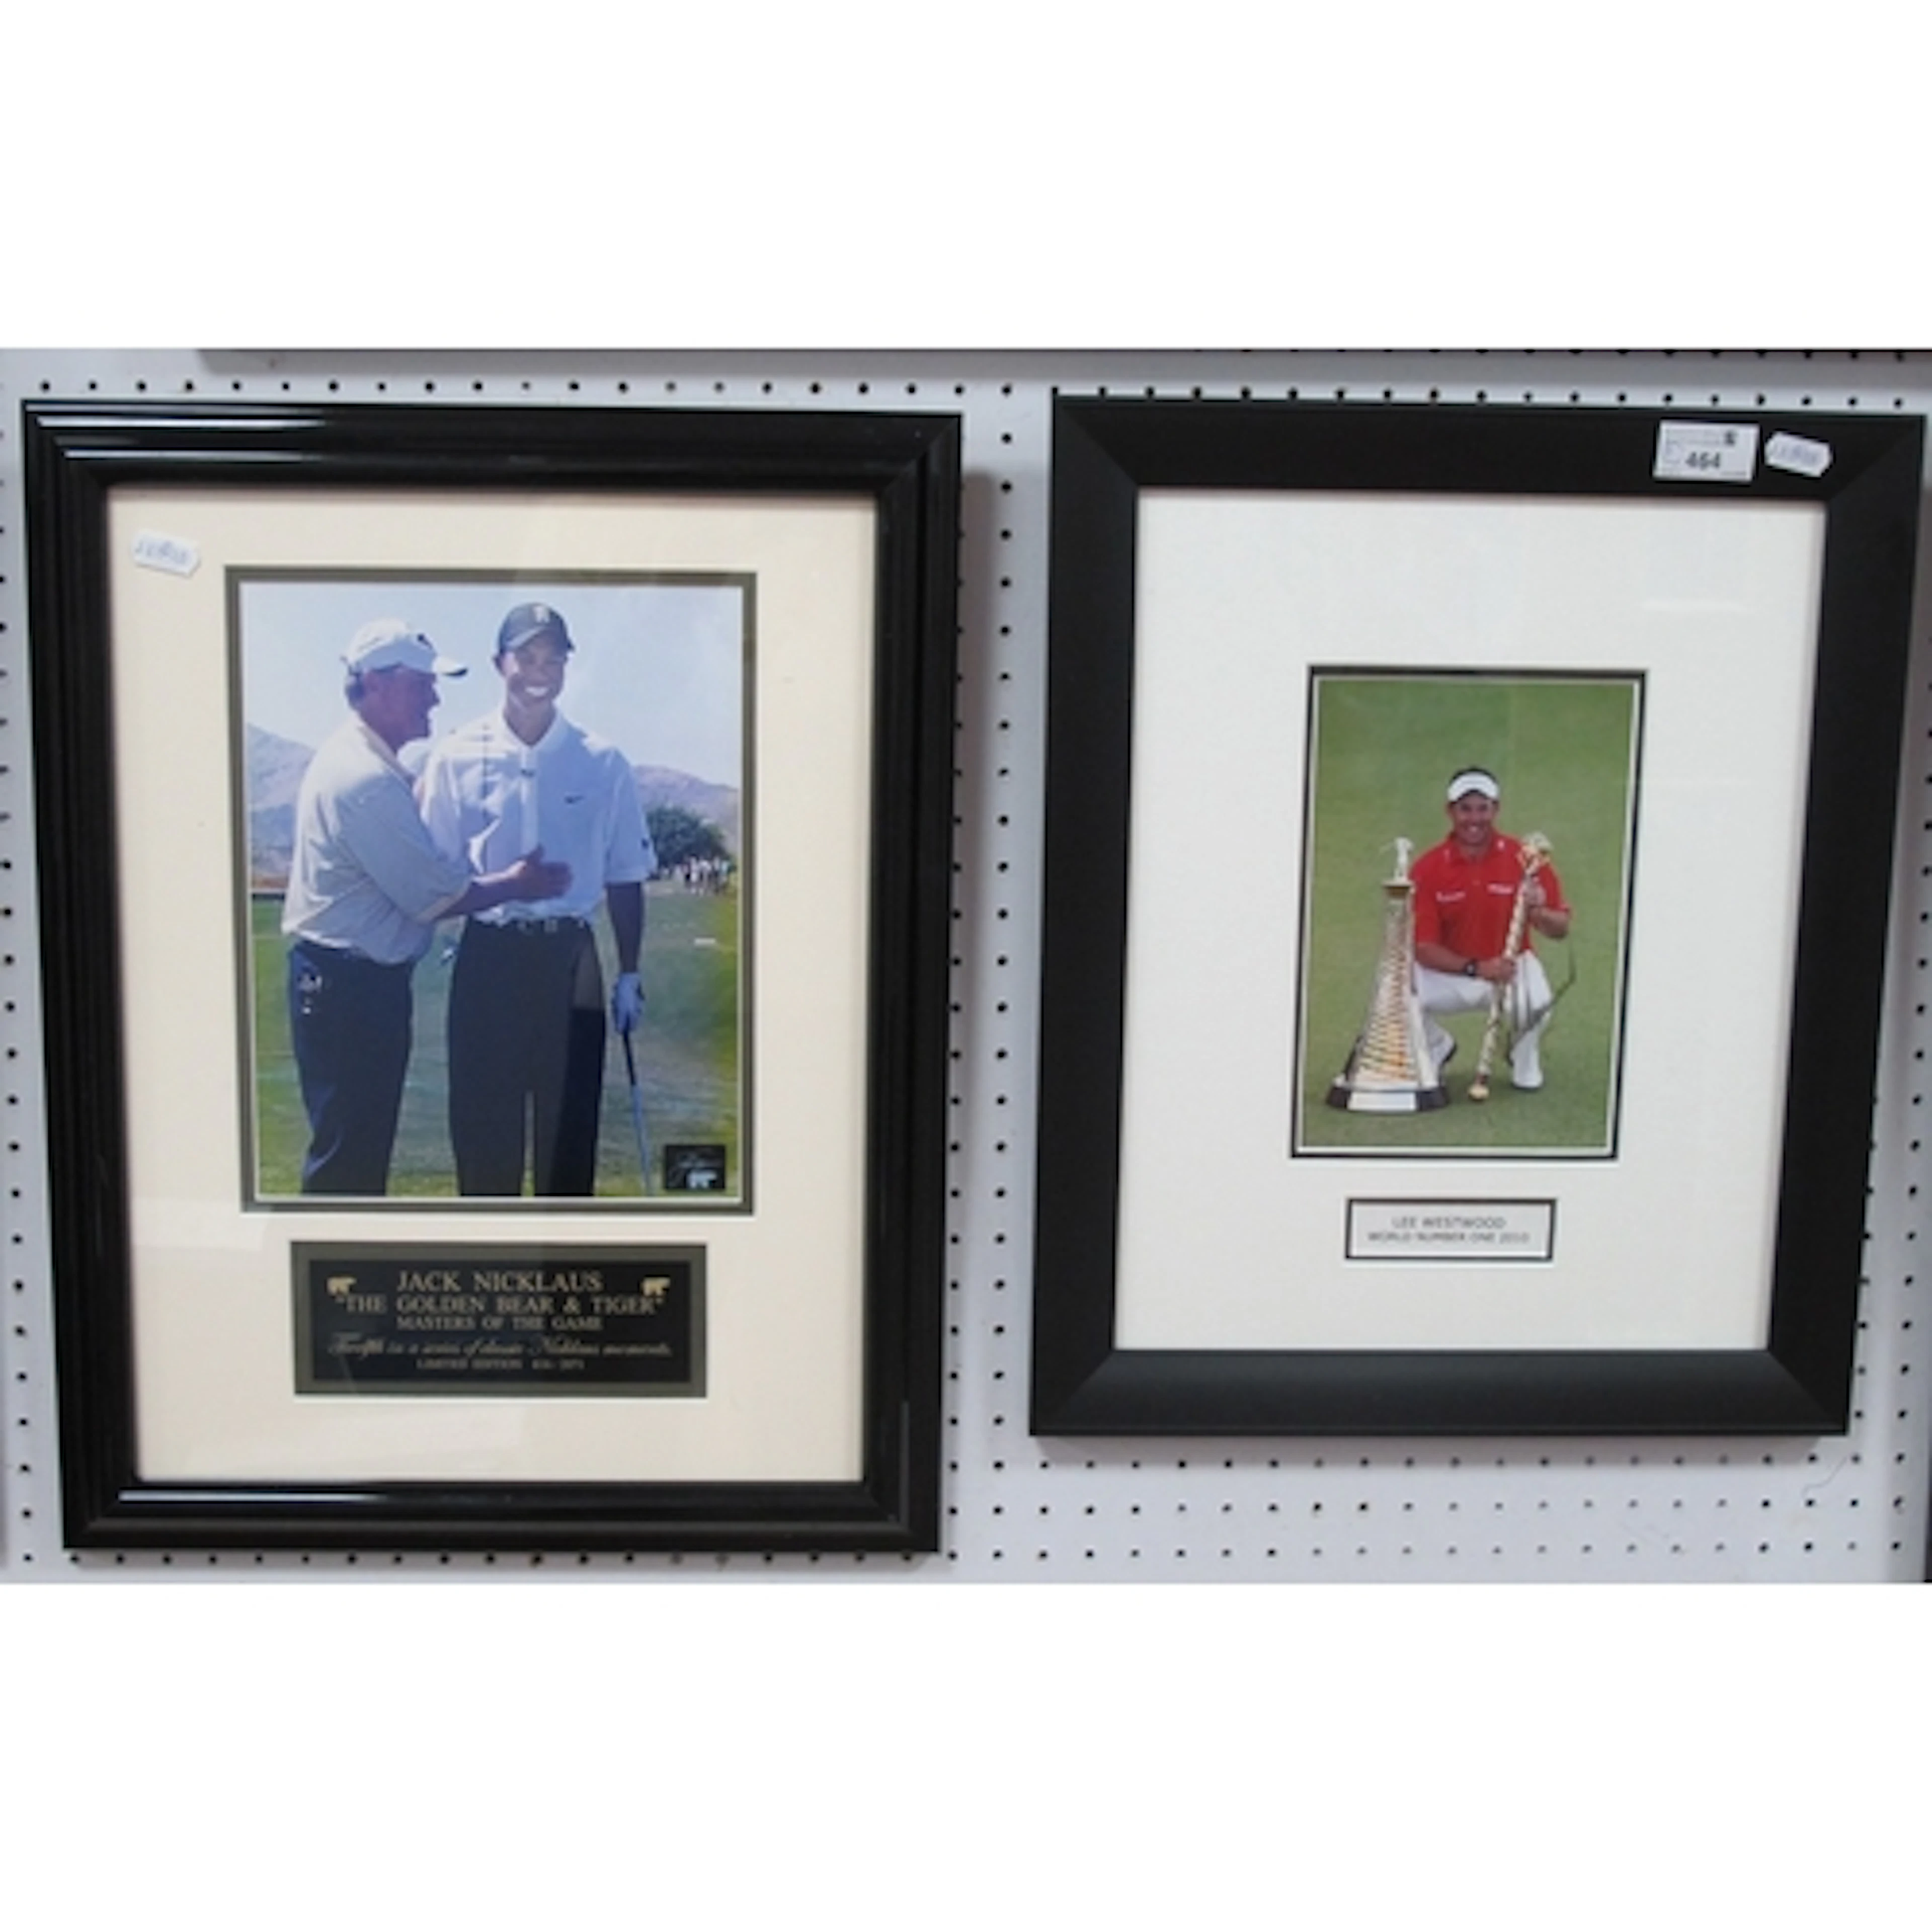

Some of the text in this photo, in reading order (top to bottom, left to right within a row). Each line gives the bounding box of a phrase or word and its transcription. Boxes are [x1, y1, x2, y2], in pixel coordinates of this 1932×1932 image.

[1685, 451, 1722, 470] 464
[1391, 1216, 1507, 1229] LEE WESTWOOD
[397, 1270, 604, 1294] JACK NICKLAUS
[396, 1294, 486, 1314] GOLDEN
[497, 1294, 555, 1314] BEAR
[562, 1294, 582, 1314] &
[396, 1316, 604, 1332] MASTERS OF THE GAME
